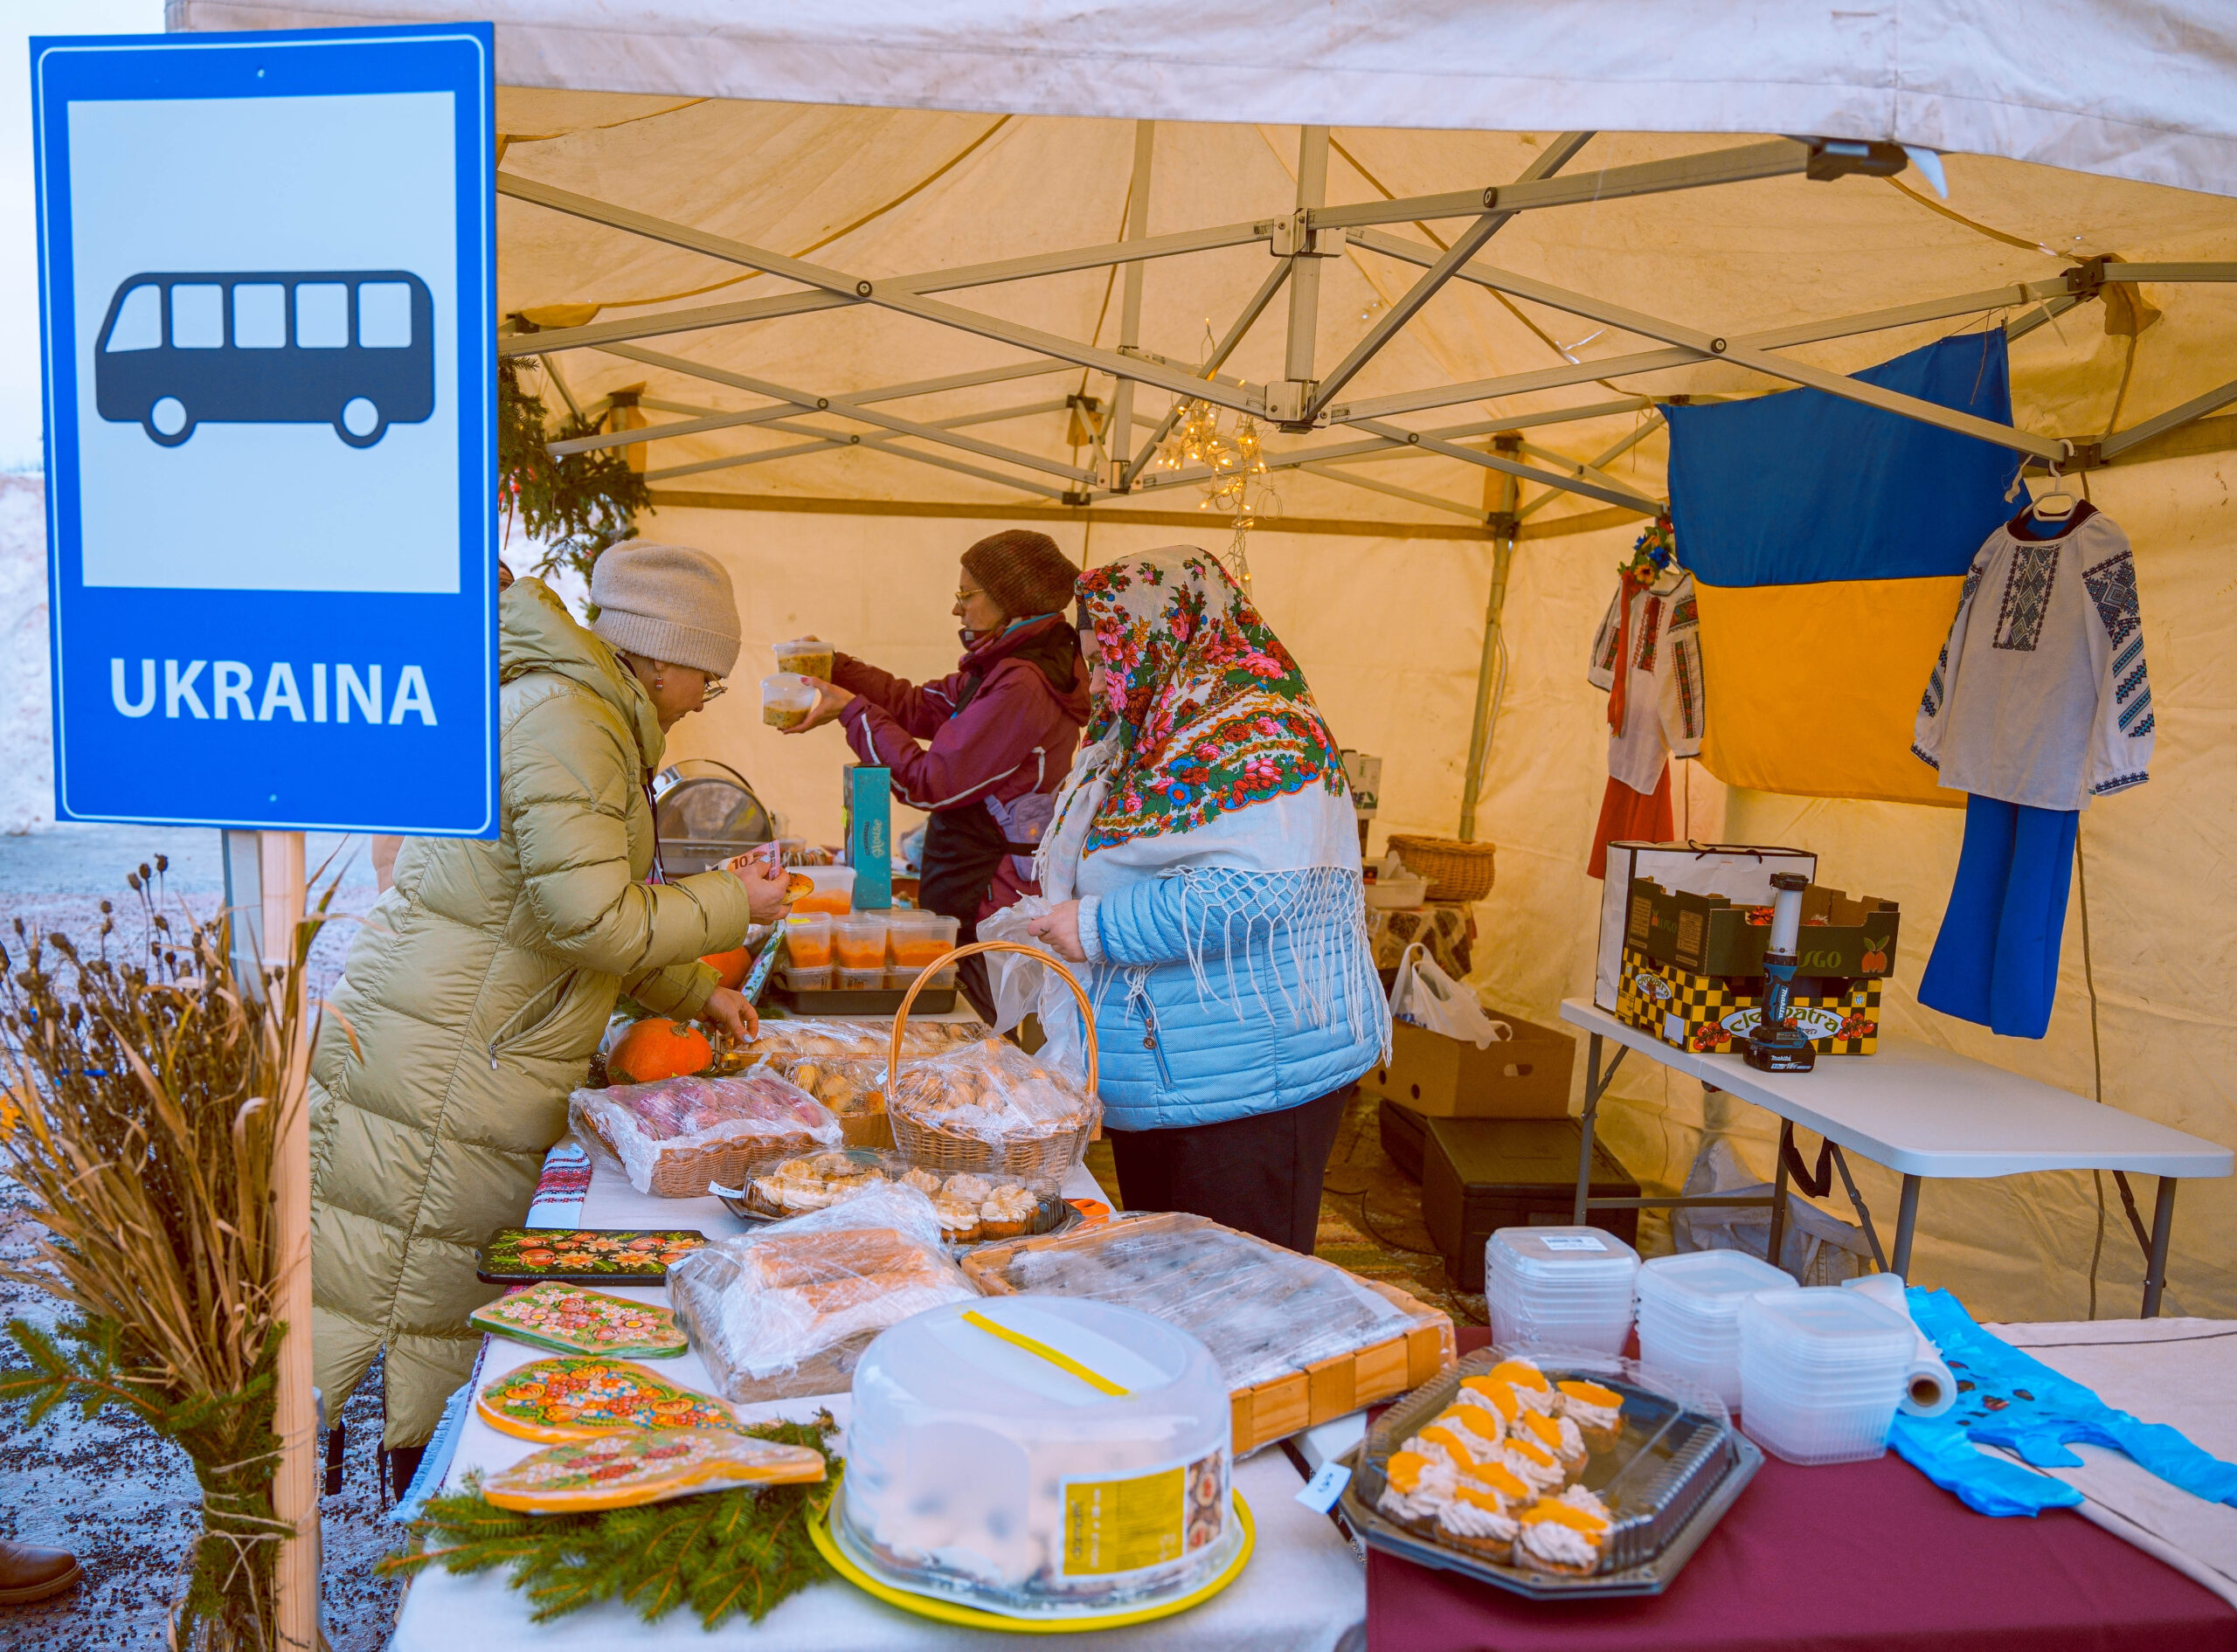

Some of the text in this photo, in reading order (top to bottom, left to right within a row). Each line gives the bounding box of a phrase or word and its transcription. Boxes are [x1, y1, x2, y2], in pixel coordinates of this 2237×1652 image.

[110, 658, 439, 726] UKRAINA
[731, 856, 748, 869] 10
[1729, 1006, 1839, 1033] clepatra
